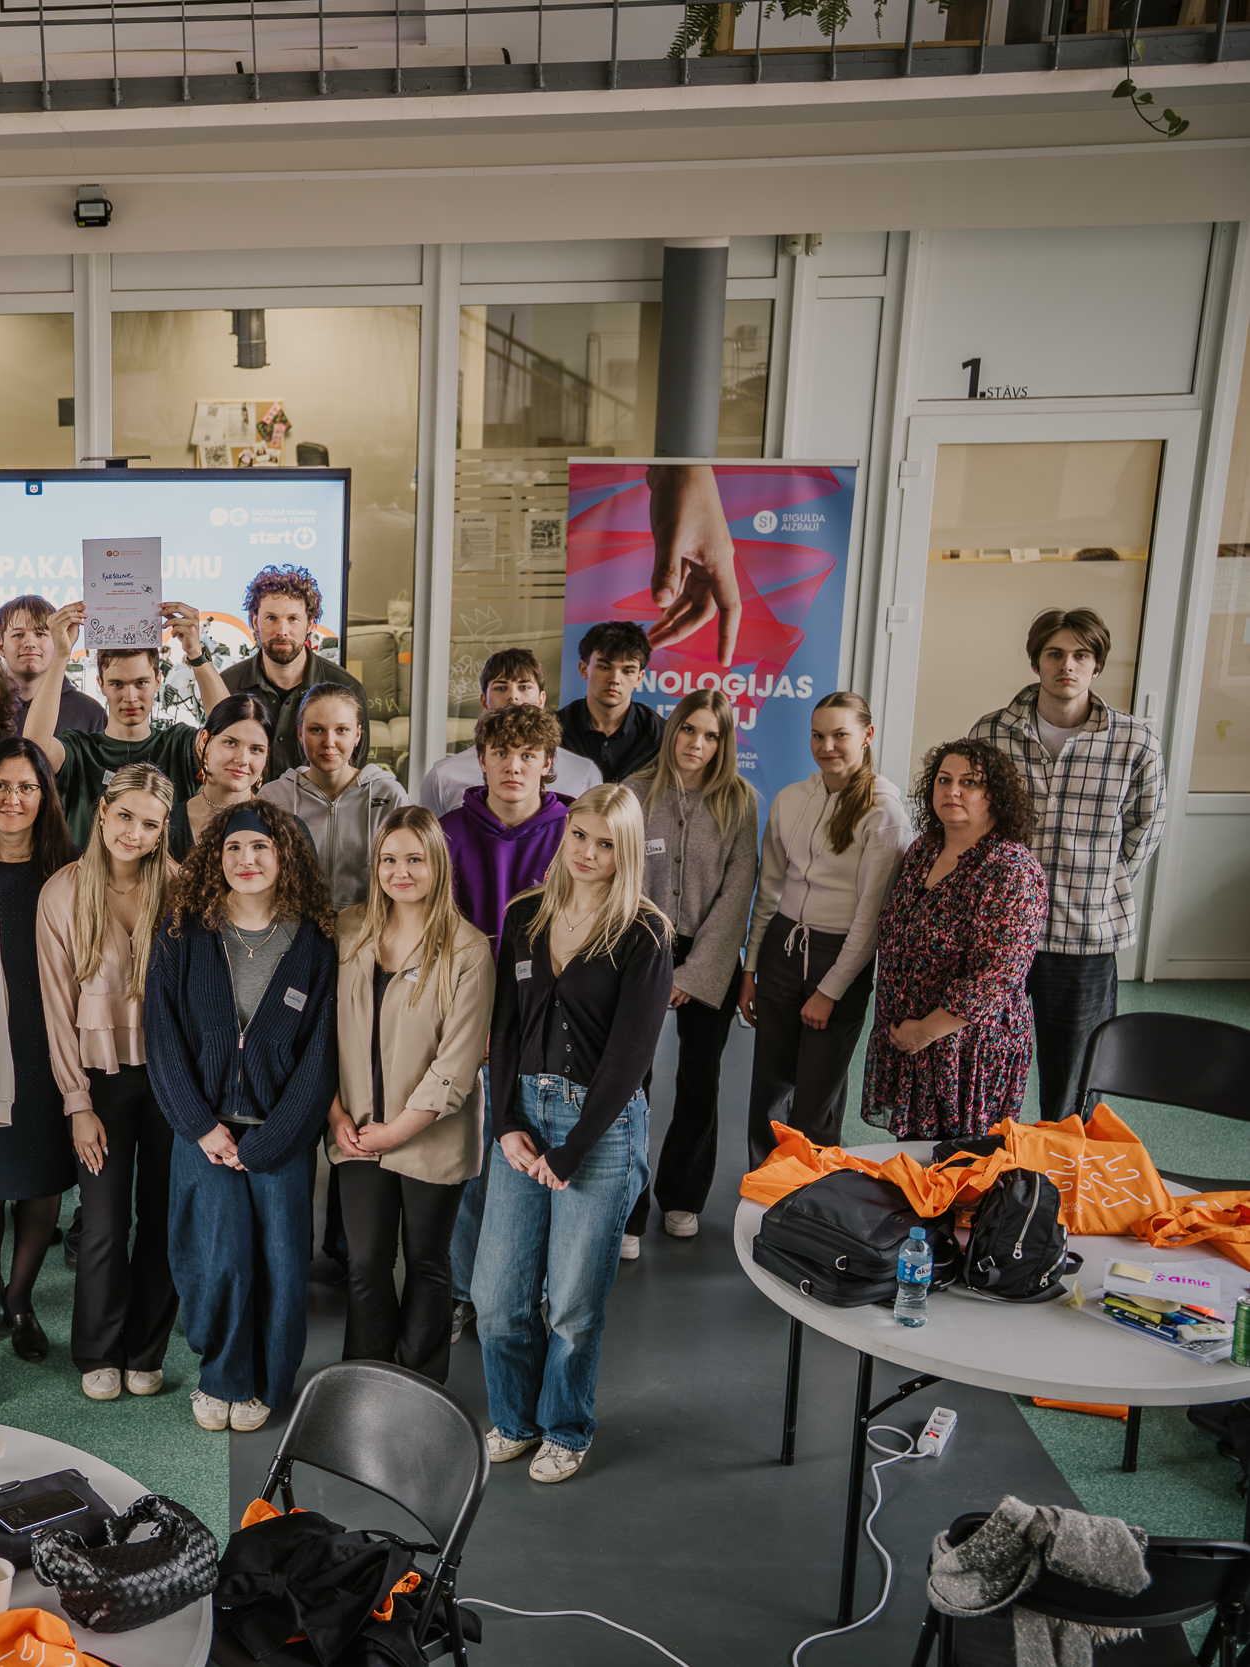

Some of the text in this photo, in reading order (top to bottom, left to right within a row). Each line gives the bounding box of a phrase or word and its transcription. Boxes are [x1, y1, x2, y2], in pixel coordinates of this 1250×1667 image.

[987, 384, 1028, 399] STĀVS
[249, 530, 292, 544] start
[636, 670, 813, 704] NOLOĢIJAS
